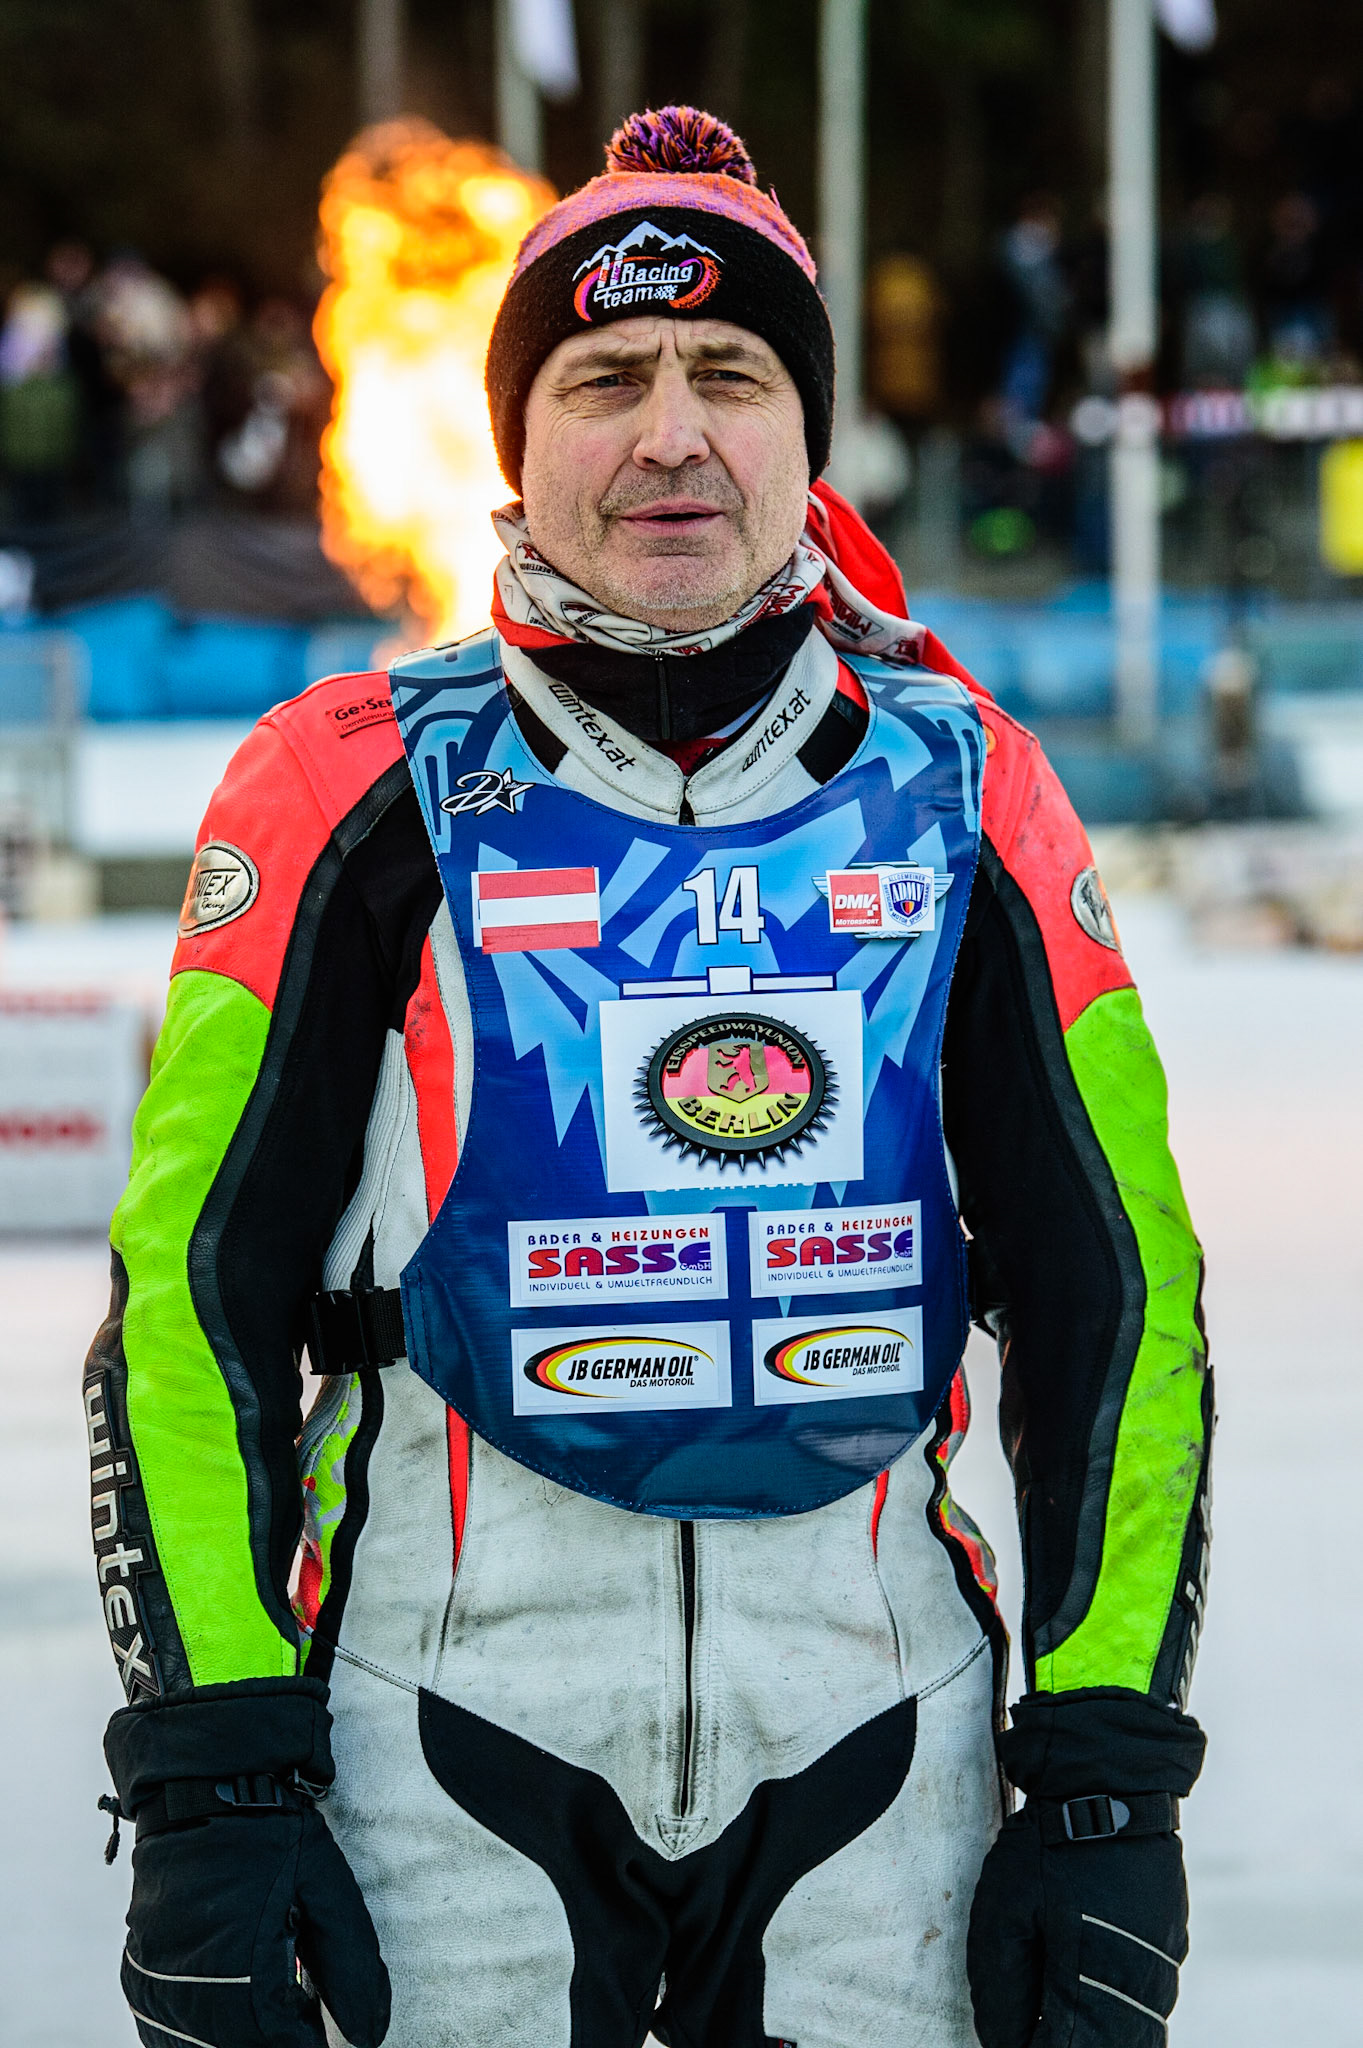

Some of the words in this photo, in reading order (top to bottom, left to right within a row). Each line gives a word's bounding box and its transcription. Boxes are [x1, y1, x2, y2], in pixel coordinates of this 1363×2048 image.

[621, 262, 694, 282] Racing
[594, 284, 653, 309] team
[888, 872, 926, 882] ALLGEMEINER
[891, 881, 925, 903] ADMV
[682, 865, 765, 945] 14
[665, 1022, 806, 1073] EISSPEEDWAYUNION
[677, 1093, 803, 1134] BERLIN
[824, 1221, 834, 1232] &
[841, 1214, 913, 1231] HEIZUNGEN
[591, 1231, 602, 1243] &
[611, 1227, 710, 1242] HEIZUNGEN
[766, 1228, 914, 1269] SASSE
[528, 1241, 712, 1279] SASSE
[768, 1270, 824, 1282] INDIVIDUELL
[827, 1269, 834, 1278] &
[837, 1262, 914, 1278] UMWELTFREUNDLICH
[529, 1281, 591, 1292] INDIVIDUELL
[595, 1280, 603, 1289] &
[607, 1276, 713, 1289] UMWELTFREUNDLICH
[568, 1359, 589, 1381] JB
[591, 1356, 668, 1380] GERMAN
[803, 1350, 820, 1371] JB
[822, 1344, 880, 1370] GERMAN
[852, 1367, 866, 1376] DAS
[867, 1363, 901, 1375] MOTOROIL
[630, 1379, 648, 1388] DAS
[649, 1377, 695, 1388] MOTOROIL
